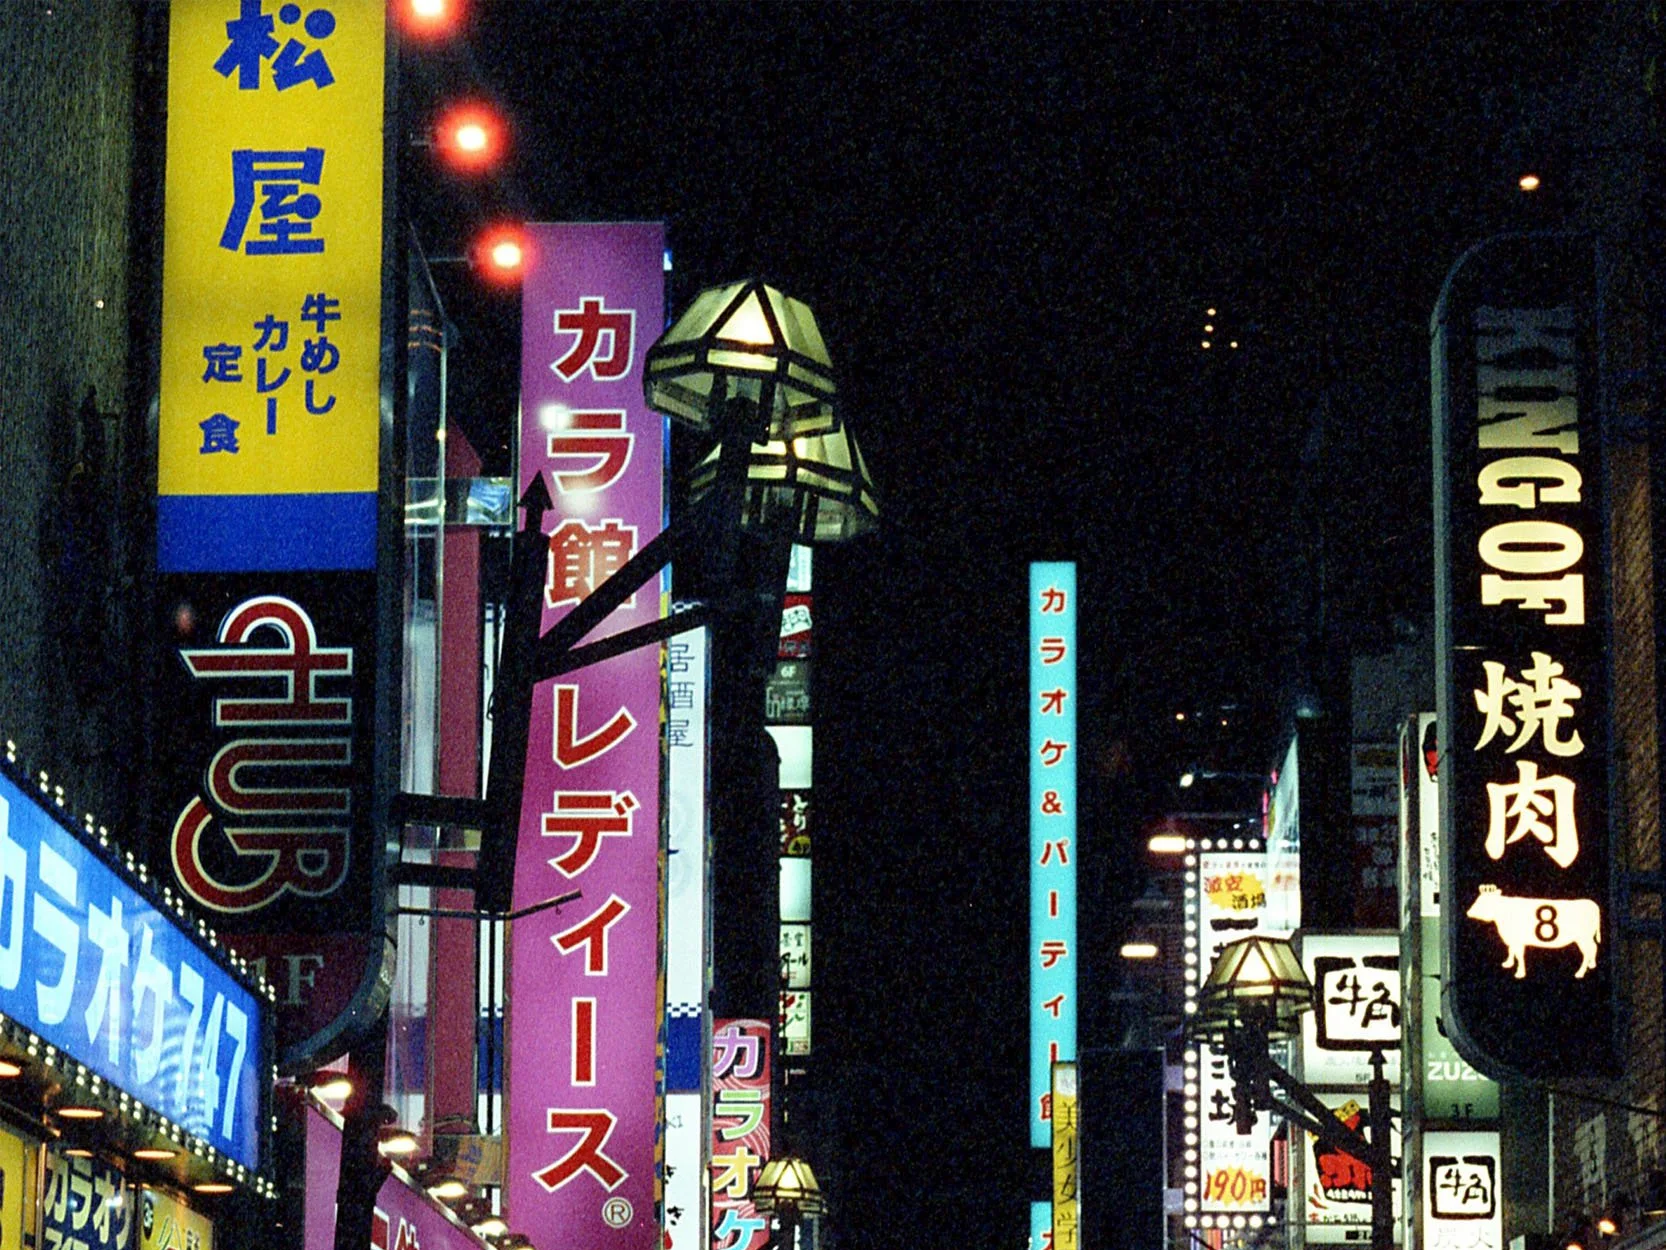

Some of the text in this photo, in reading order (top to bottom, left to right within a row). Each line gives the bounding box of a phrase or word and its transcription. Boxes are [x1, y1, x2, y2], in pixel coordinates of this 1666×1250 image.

[213, 0, 336, 255] 松屋
[252, 315, 291, 435] カレー
[300, 294, 341, 416] 牛めし
[199, 344, 243, 455] 定食
[1473, 650, 1585, 868] 焼肉
[1534, 904, 1560, 942] 8
[1328, 974, 1400, 1029] 牛角
[1427, 1061, 1490, 1081] ZUZ
[1203, 1169, 1267, 1203] 190円
[1440, 1168, 1489, 1206] 牛角
